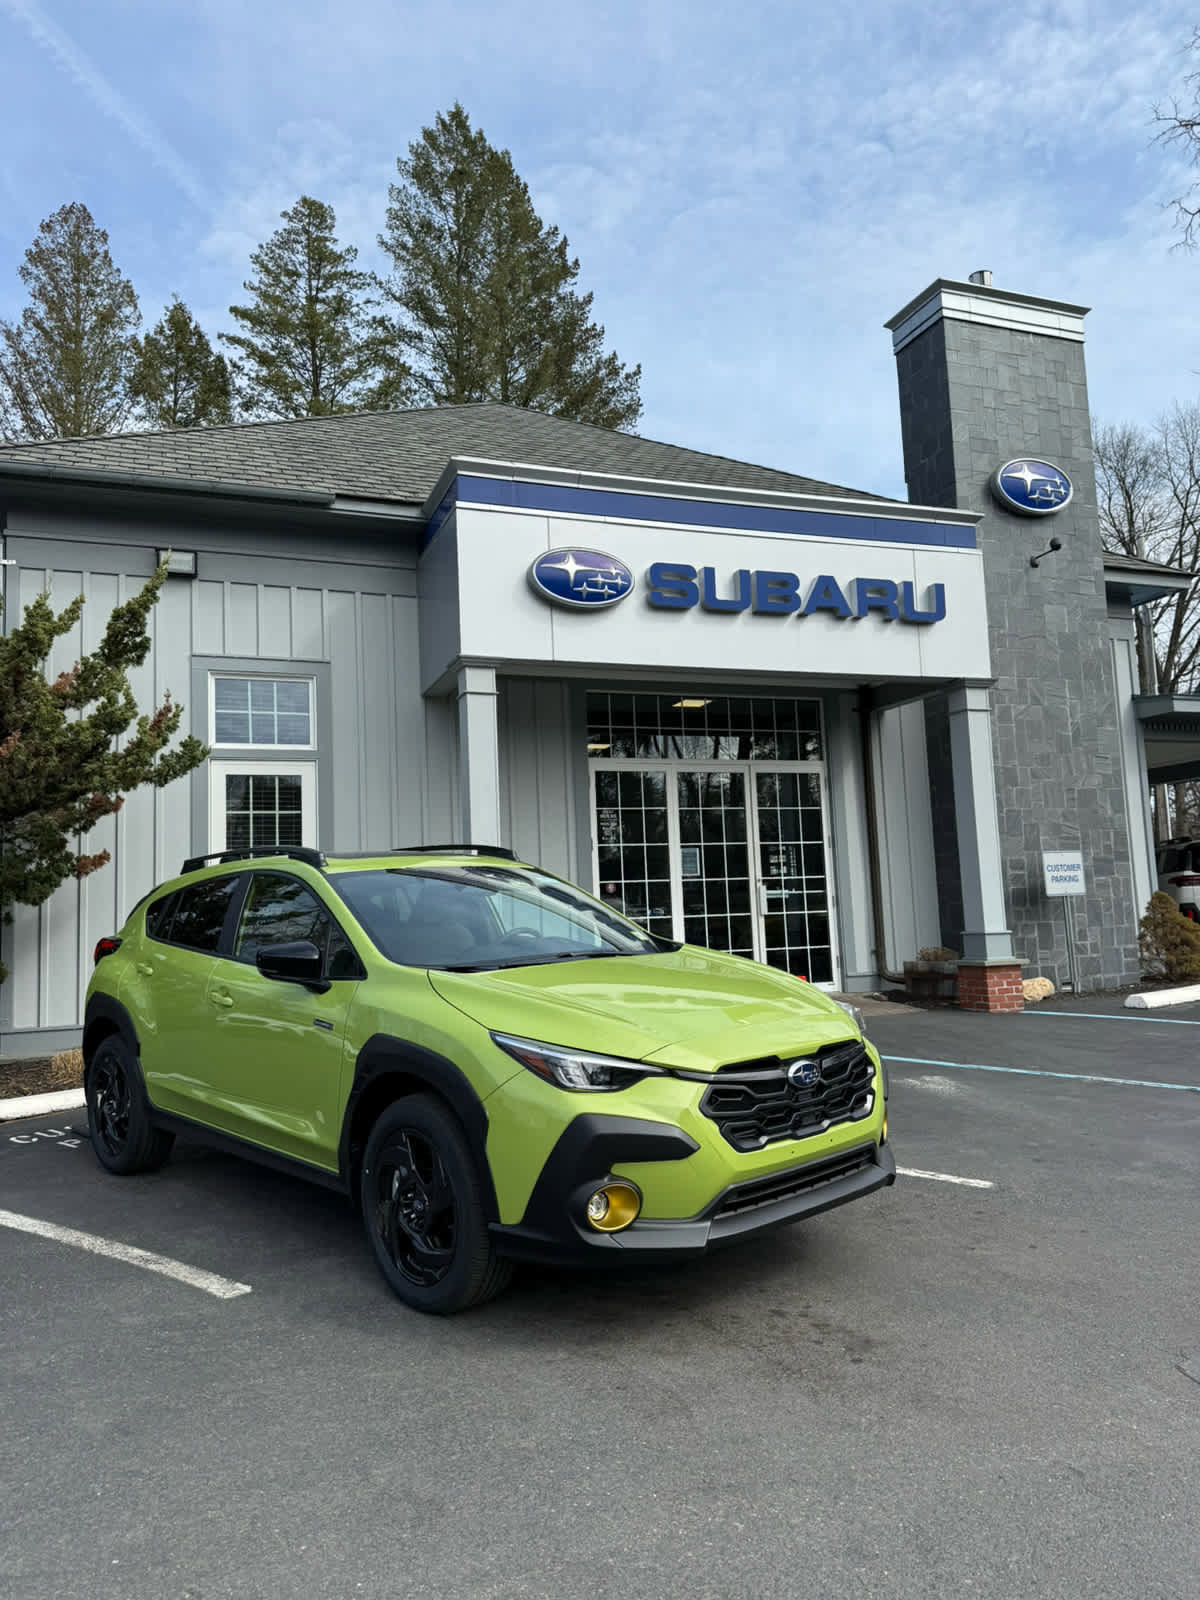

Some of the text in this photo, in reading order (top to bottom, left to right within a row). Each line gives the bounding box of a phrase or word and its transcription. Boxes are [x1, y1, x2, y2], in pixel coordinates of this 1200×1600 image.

[646, 562, 946, 623] SUBARU
[1046, 864, 1081, 873] CUSTOMER
[1050, 875, 1079, 884] PARKING
[9, 1126, 72, 1144] CU
